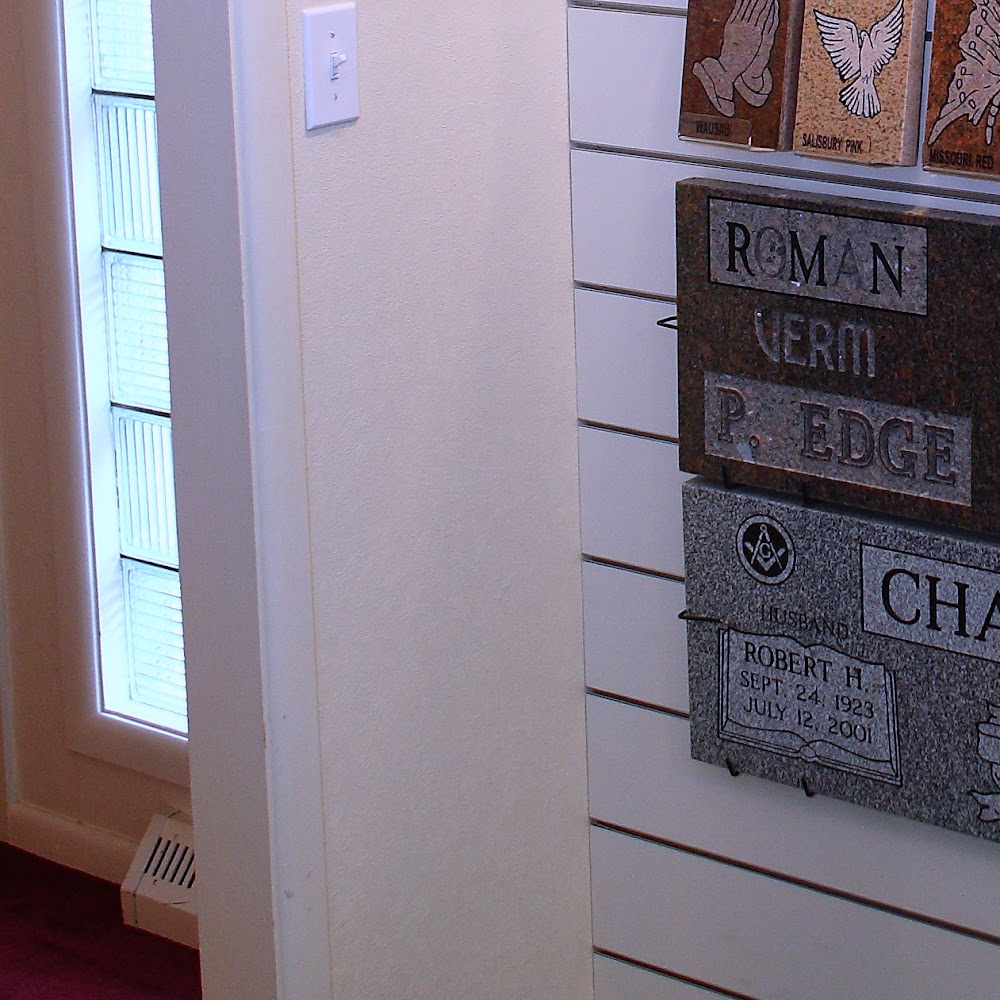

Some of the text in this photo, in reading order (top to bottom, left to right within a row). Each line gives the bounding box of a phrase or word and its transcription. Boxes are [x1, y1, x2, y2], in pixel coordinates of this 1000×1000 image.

[802, 132, 863, 153] SALISBURY PINK
[929, 149, 994, 169] MISSOURI RED
[725, 221, 904, 298] ROMAN
[800, 400, 956, 486] EDGE
[761, 604, 849, 643] HUSBAND
[744, 641, 869, 692] ROBERT H.
[740, 670, 787, 698] SEPT.
[835, 694, 874, 718] 1923
[743, 697, 786, 720] JULY
[828, 715, 872, 743] 2001
